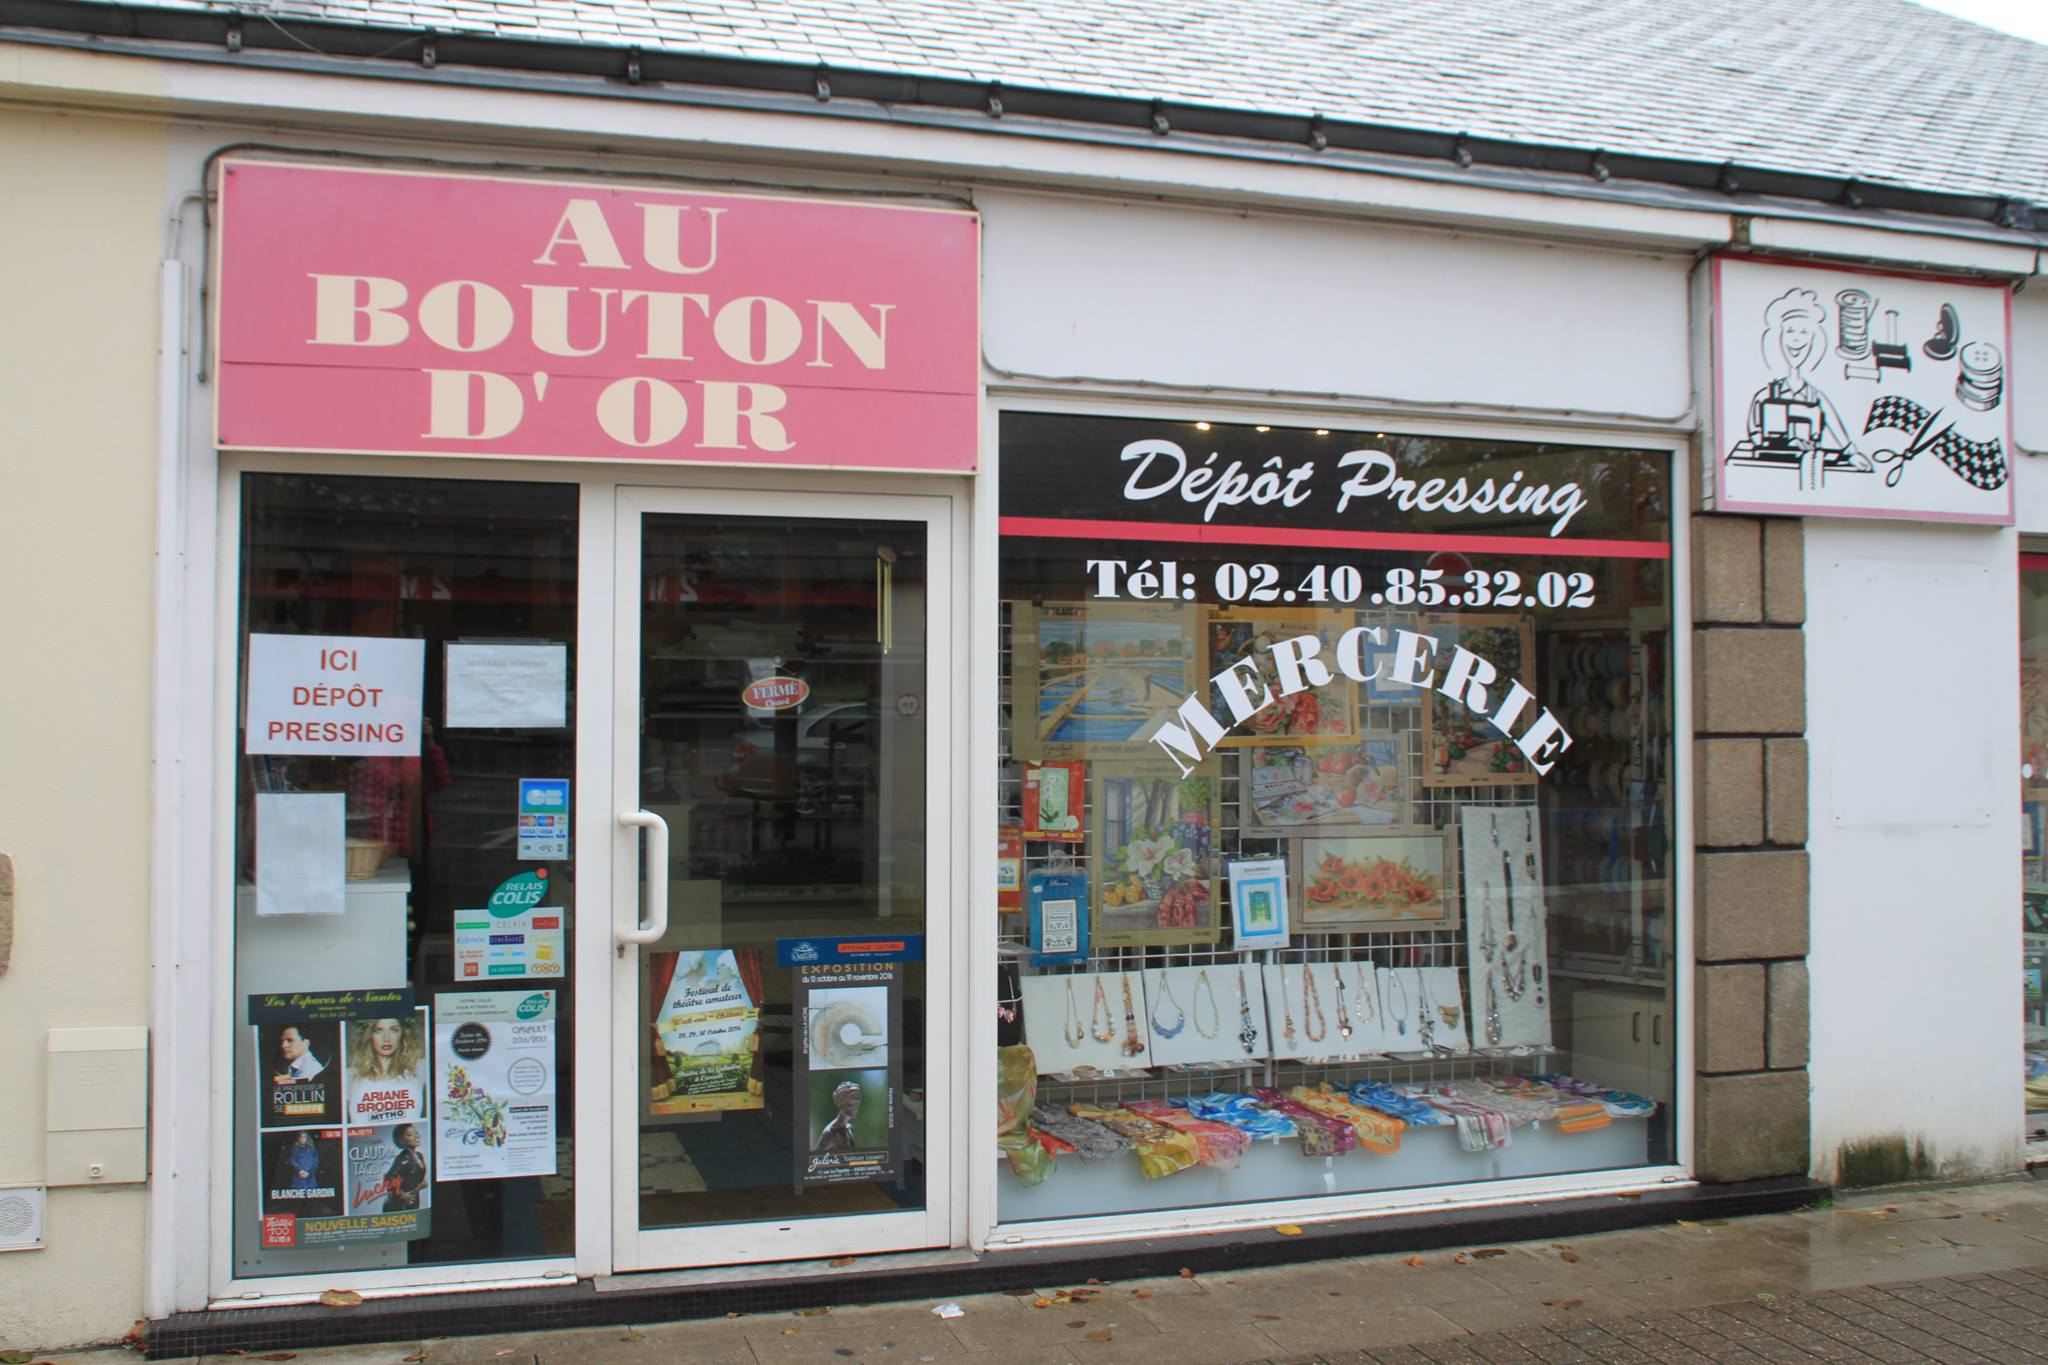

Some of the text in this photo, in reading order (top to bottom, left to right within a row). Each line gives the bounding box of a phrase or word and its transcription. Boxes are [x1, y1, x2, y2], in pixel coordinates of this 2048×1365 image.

[533, 199, 728, 275] AU
[306, 272, 896, 370] BOUTON
[1120, 439, 1587, 537] Dépôt Pressing
[1087, 559, 1196, 600] Tél:
[320, 649, 358, 671] ICI
[293, 683, 384, 708] DÉPÔT
[752, 682, 799, 699] FERMÉ
[1149, 626, 1574, 779] MERCERIE
[268, 721, 405, 744] PRESSING
[505, 882, 544, 891] RELAIS
[492, 891, 541, 905] COLIS
[801, 962, 894, 975] EXPOSITION
[683, 982, 732, 998] Festival de
[705, 993, 743, 1004] amateur
[264, 995, 286, 1007] Les
[290, 992, 336, 1011] Espaces
[339, 992, 354, 1004] de
[357, 991, 402, 1003] Nantes
[274, 1090, 325, 1105] ROLLIN
[362, 1090, 409, 1103] ARIANE
[274, 1104, 285, 1113] SE
[357, 1100, 415, 1113] BRODIER
[370, 1110, 404, 1121] MYTHO
[808, 1152, 841, 1173] galerie
[271, 1187, 335, 1199] BLANCHE GARDIN
[304, 1213, 417, 1232] NOUVELLE SAISON
